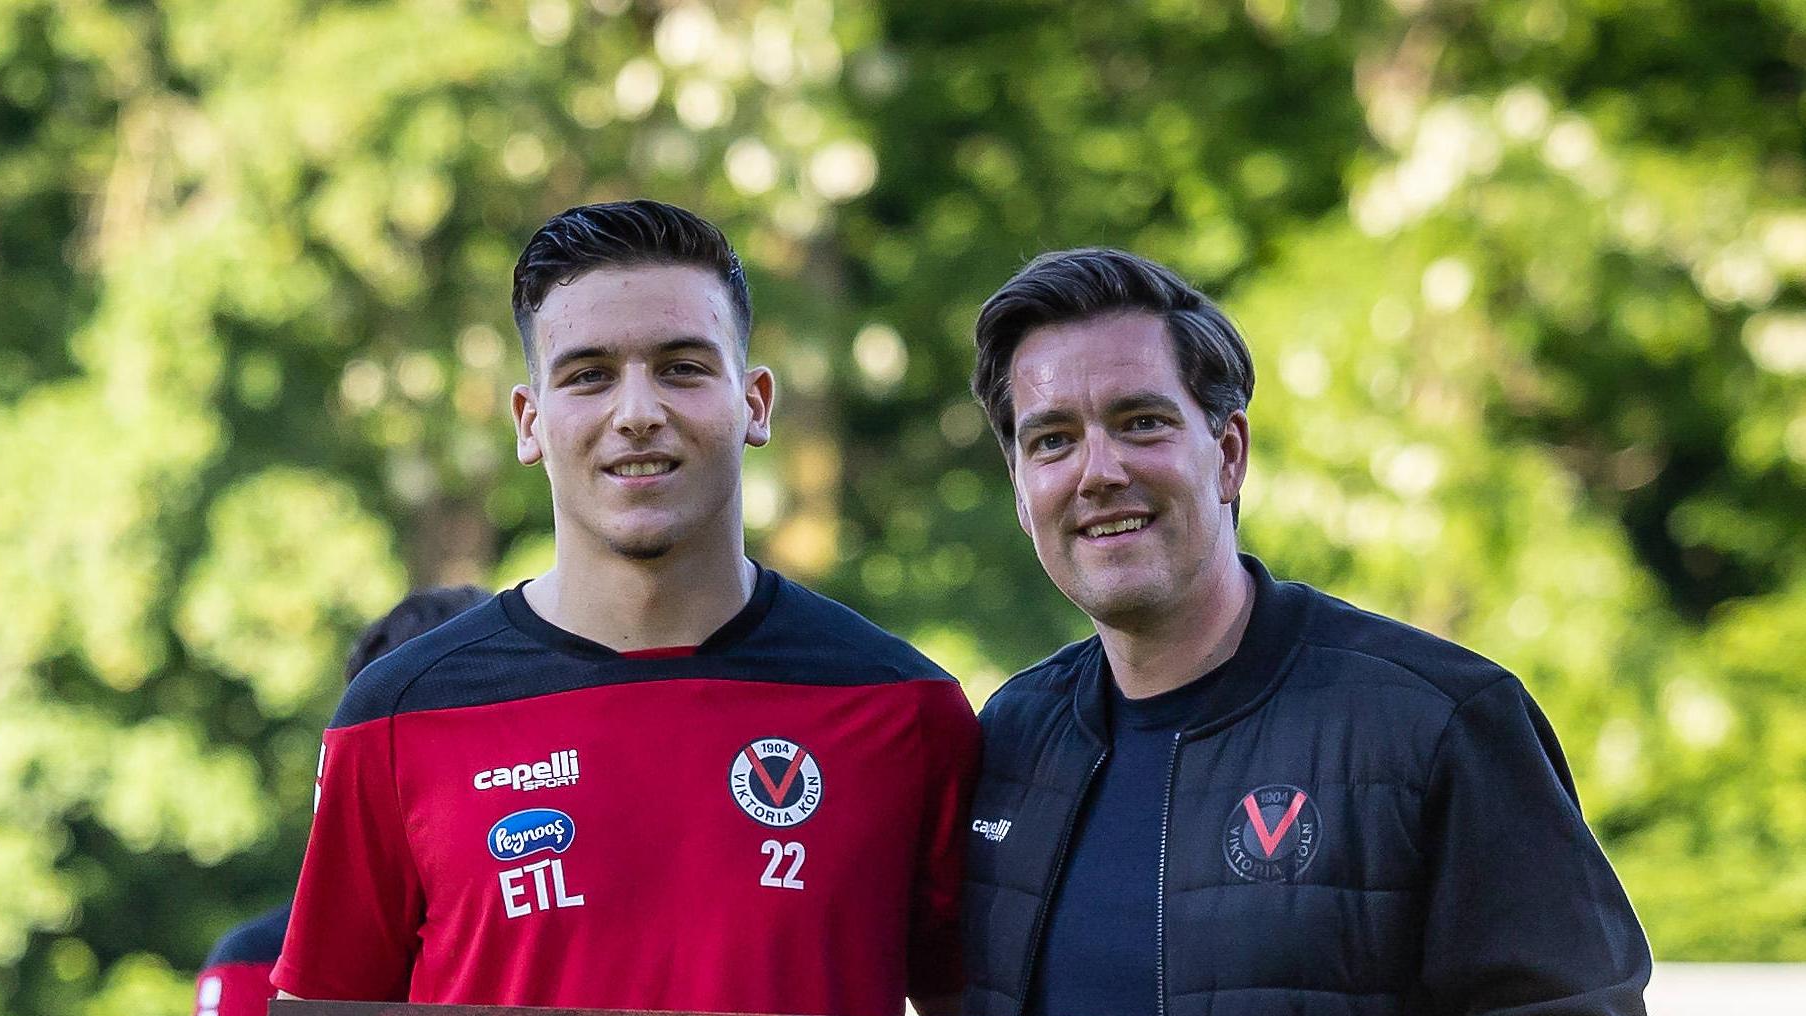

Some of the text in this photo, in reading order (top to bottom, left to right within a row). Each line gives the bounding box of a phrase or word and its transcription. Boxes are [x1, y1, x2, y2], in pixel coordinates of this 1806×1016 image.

[473, 750, 580, 791] capelli
[760, 743, 790, 754] 1904
[522, 775, 580, 792] SPORT
[734, 773, 819, 824] VIKTORIA KÖLN
[760, 839, 807, 890] 22
[498, 858, 585, 919] ETL
